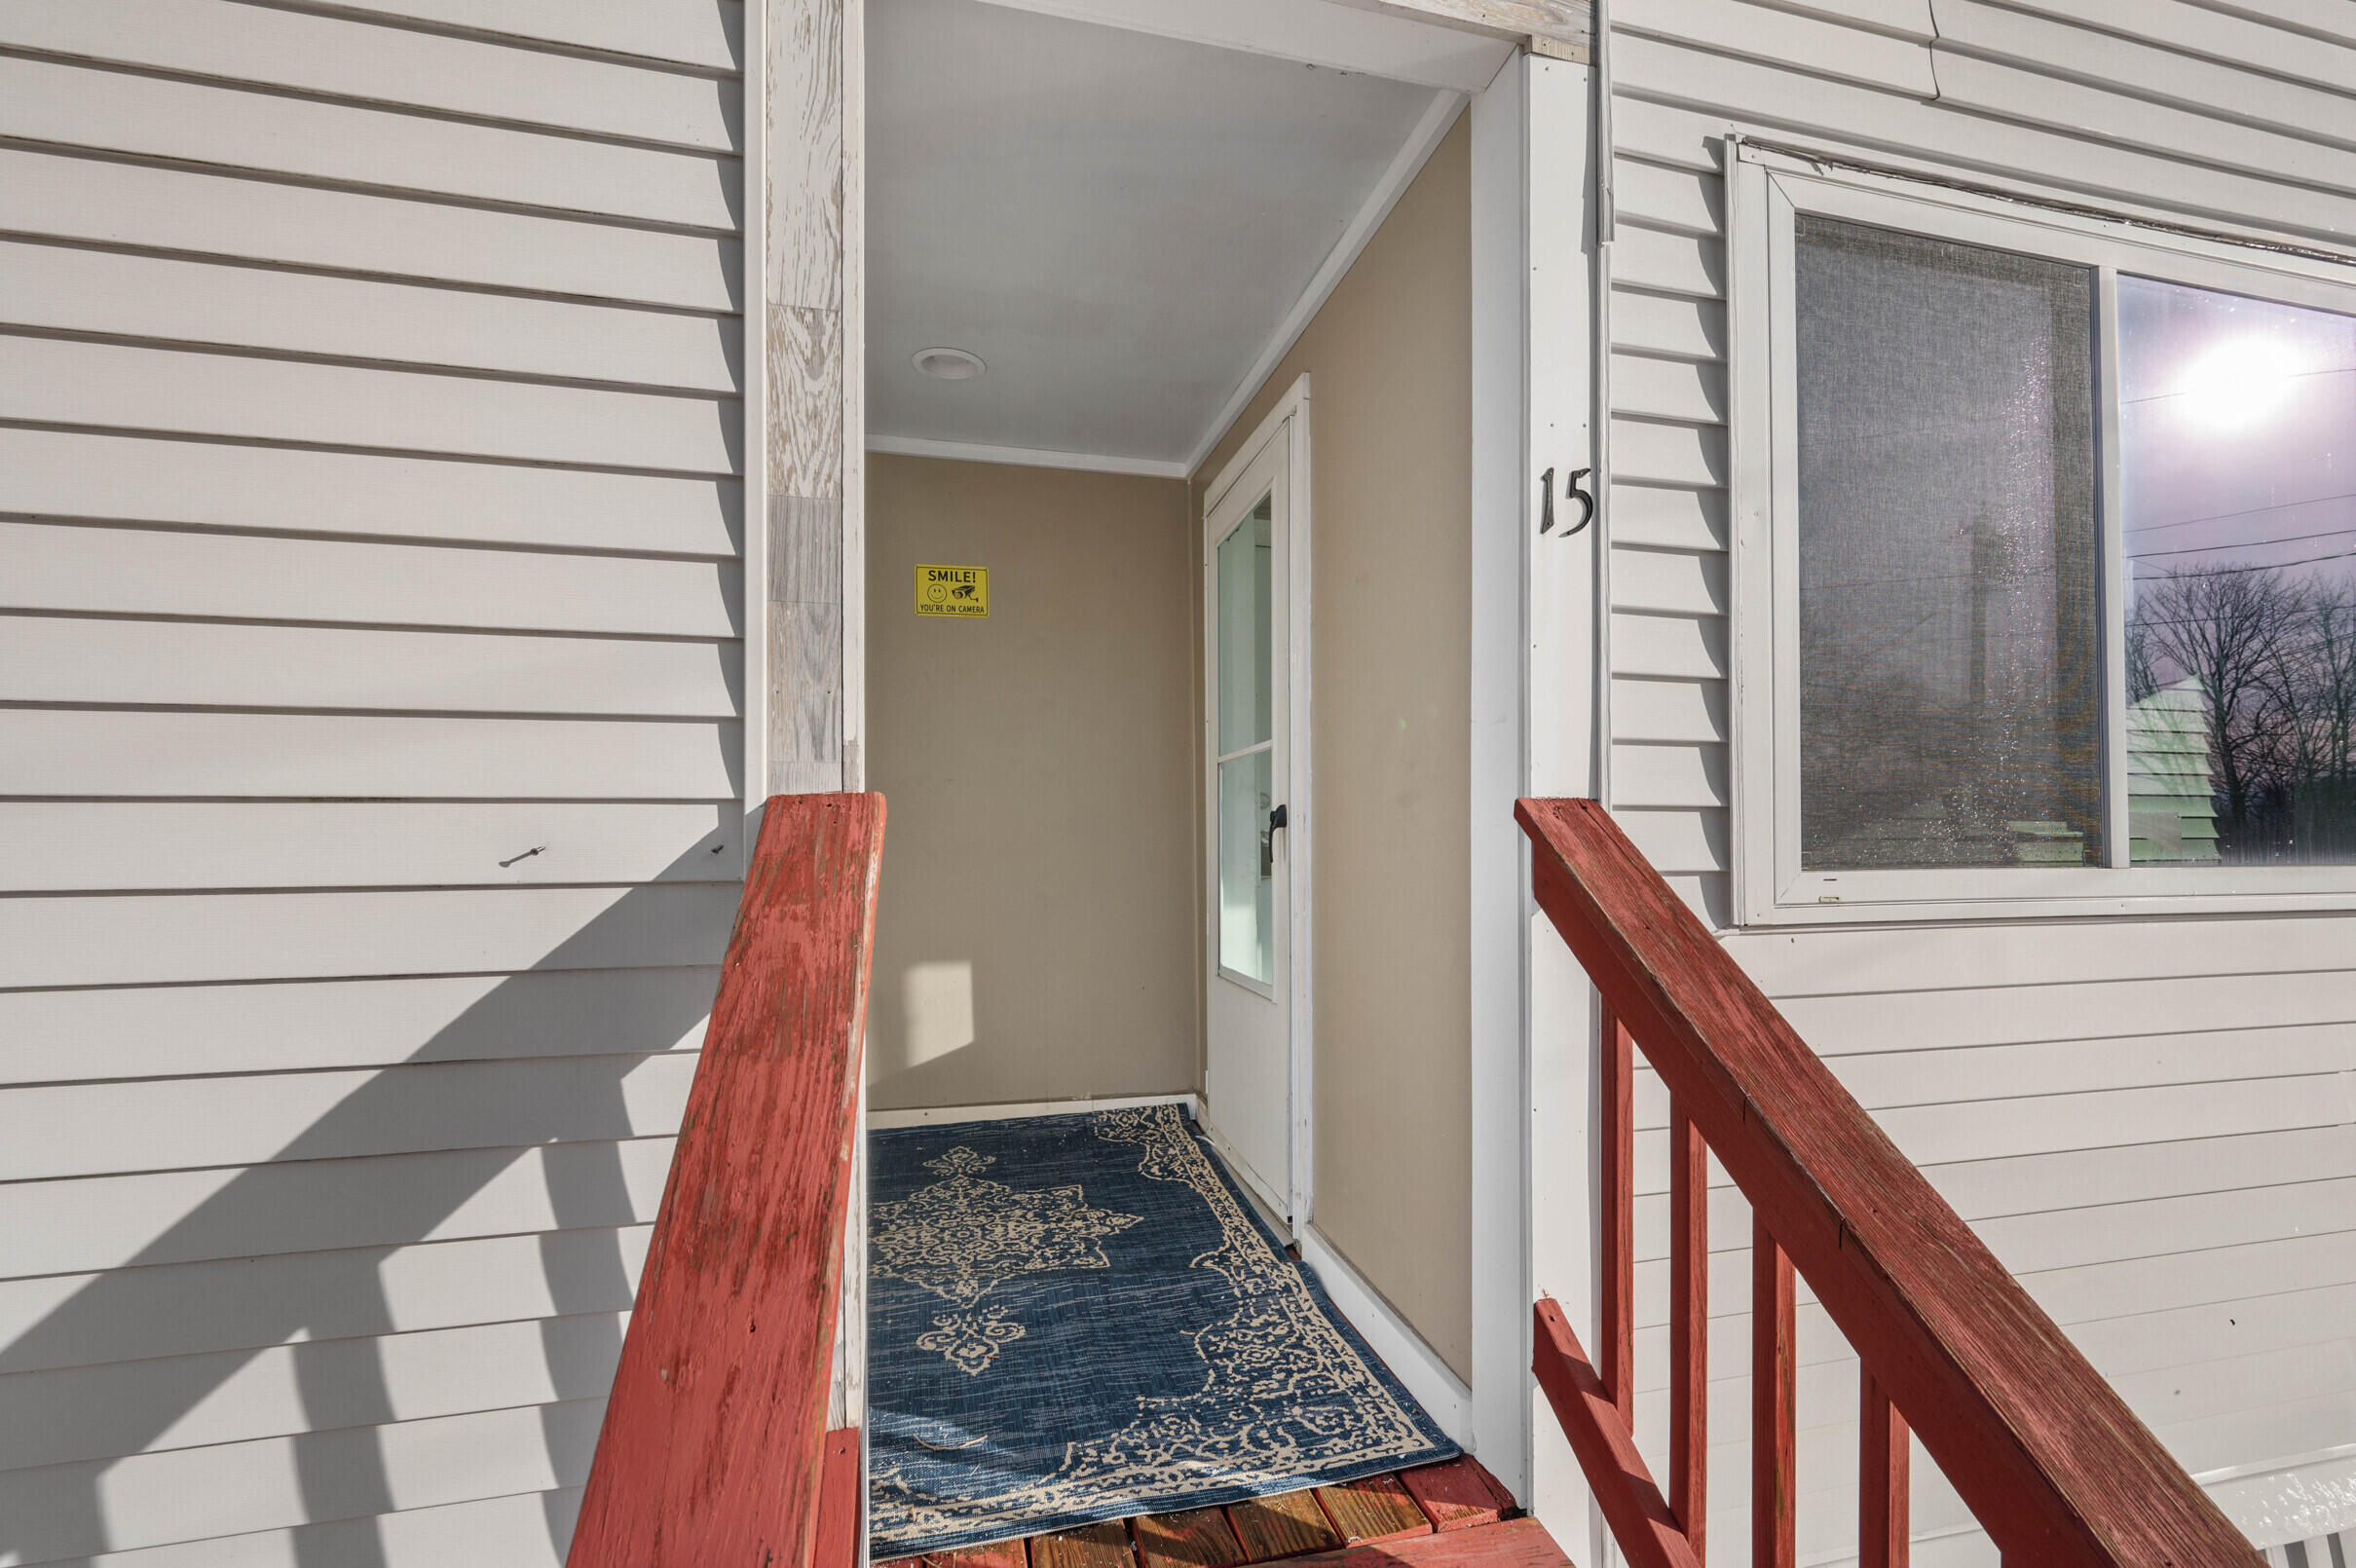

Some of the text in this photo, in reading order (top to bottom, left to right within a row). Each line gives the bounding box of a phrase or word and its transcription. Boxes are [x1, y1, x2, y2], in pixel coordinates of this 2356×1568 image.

[1541, 467, 1593, 536] 15
[928, 570, 976, 582] SMILE!
[958, 605, 985, 614] CAMERA
